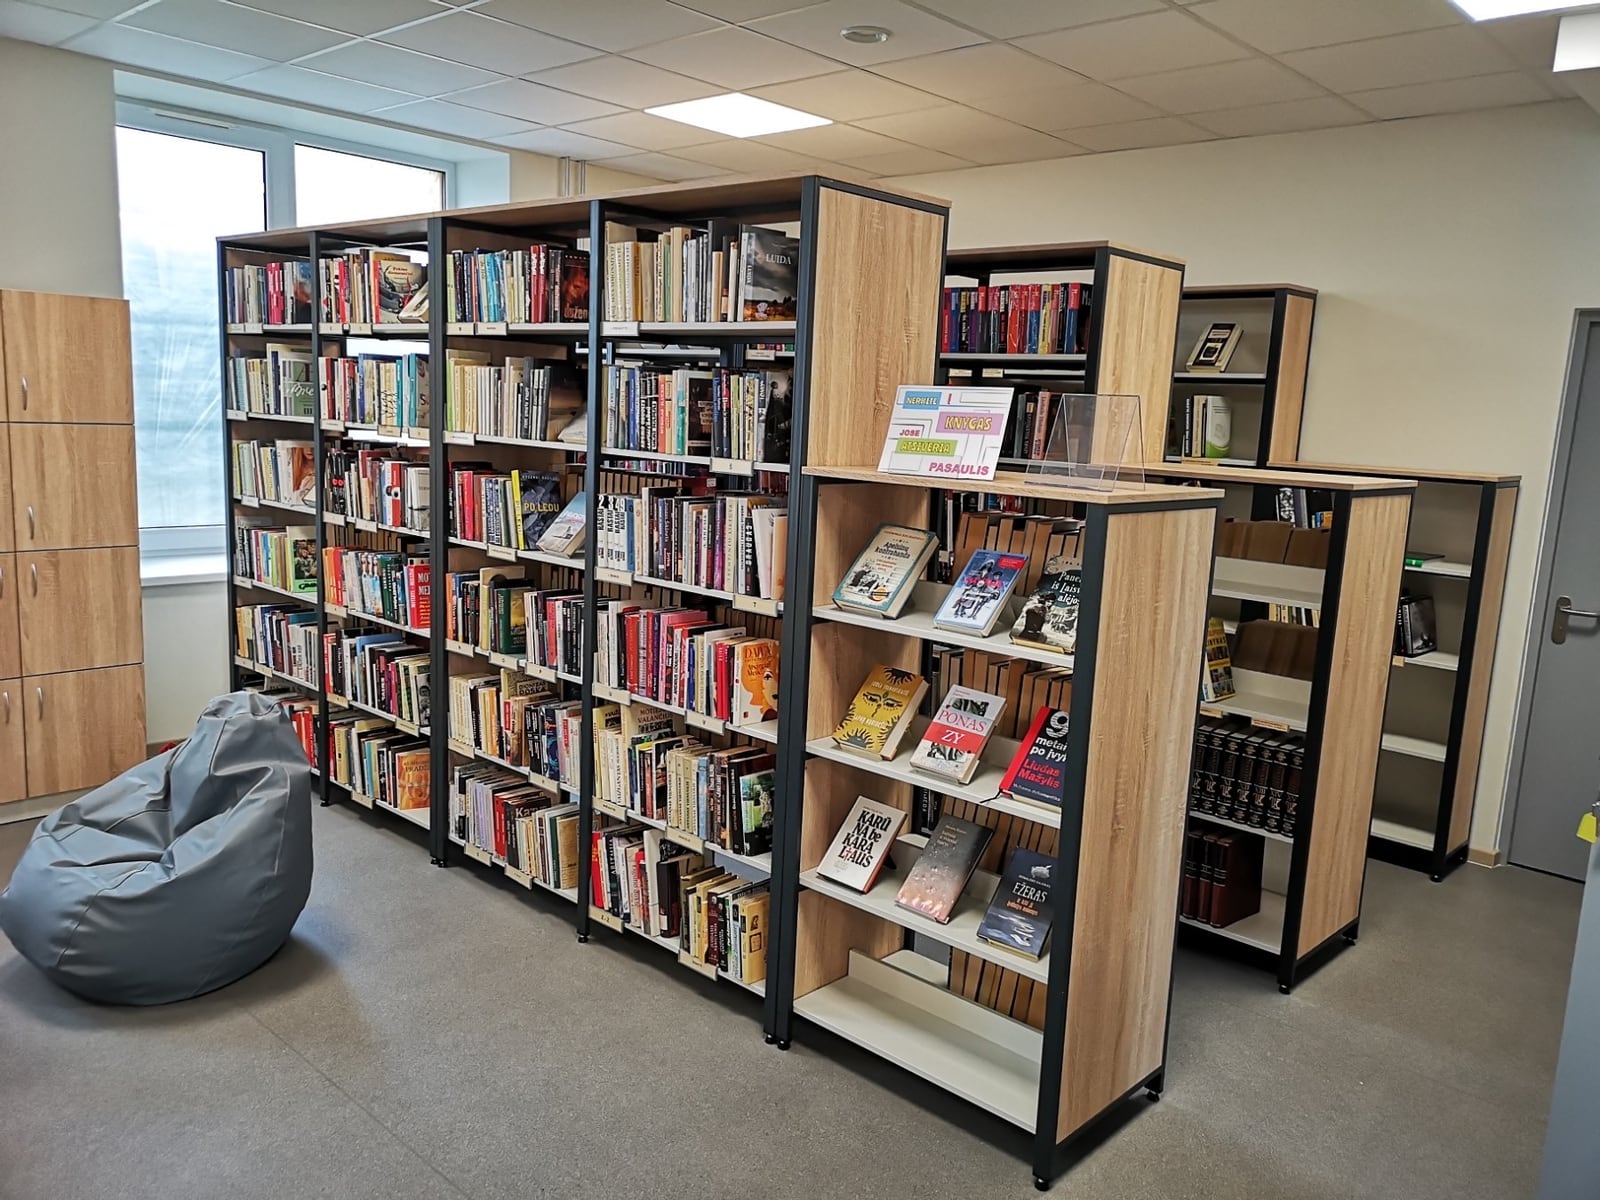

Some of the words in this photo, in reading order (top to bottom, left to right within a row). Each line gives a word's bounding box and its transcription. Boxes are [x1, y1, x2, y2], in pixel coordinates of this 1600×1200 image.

[899, 428, 921, 437] JOSE
[944, 415, 992, 432] KNYGAS
[928, 462, 990, 476] PASAULIS
[524, 503, 535, 512] PO
[538, 502, 560, 512] LEDU
[938, 710, 986, 732] PONAS
[941, 729, 965, 744] ZY
[1036, 736, 1067, 750] metai
[1030, 746, 1044, 756] po
[1023, 758, 1060, 777] Liudas
[1018, 769, 1061, 789] Mažylis
[857, 810, 891, 832] KARŪ
[852, 822, 869, 839] NA
[869, 827, 882, 842] be
[842, 833, 874, 854] KARA
[1012, 881, 1048, 903] EŽERAS
